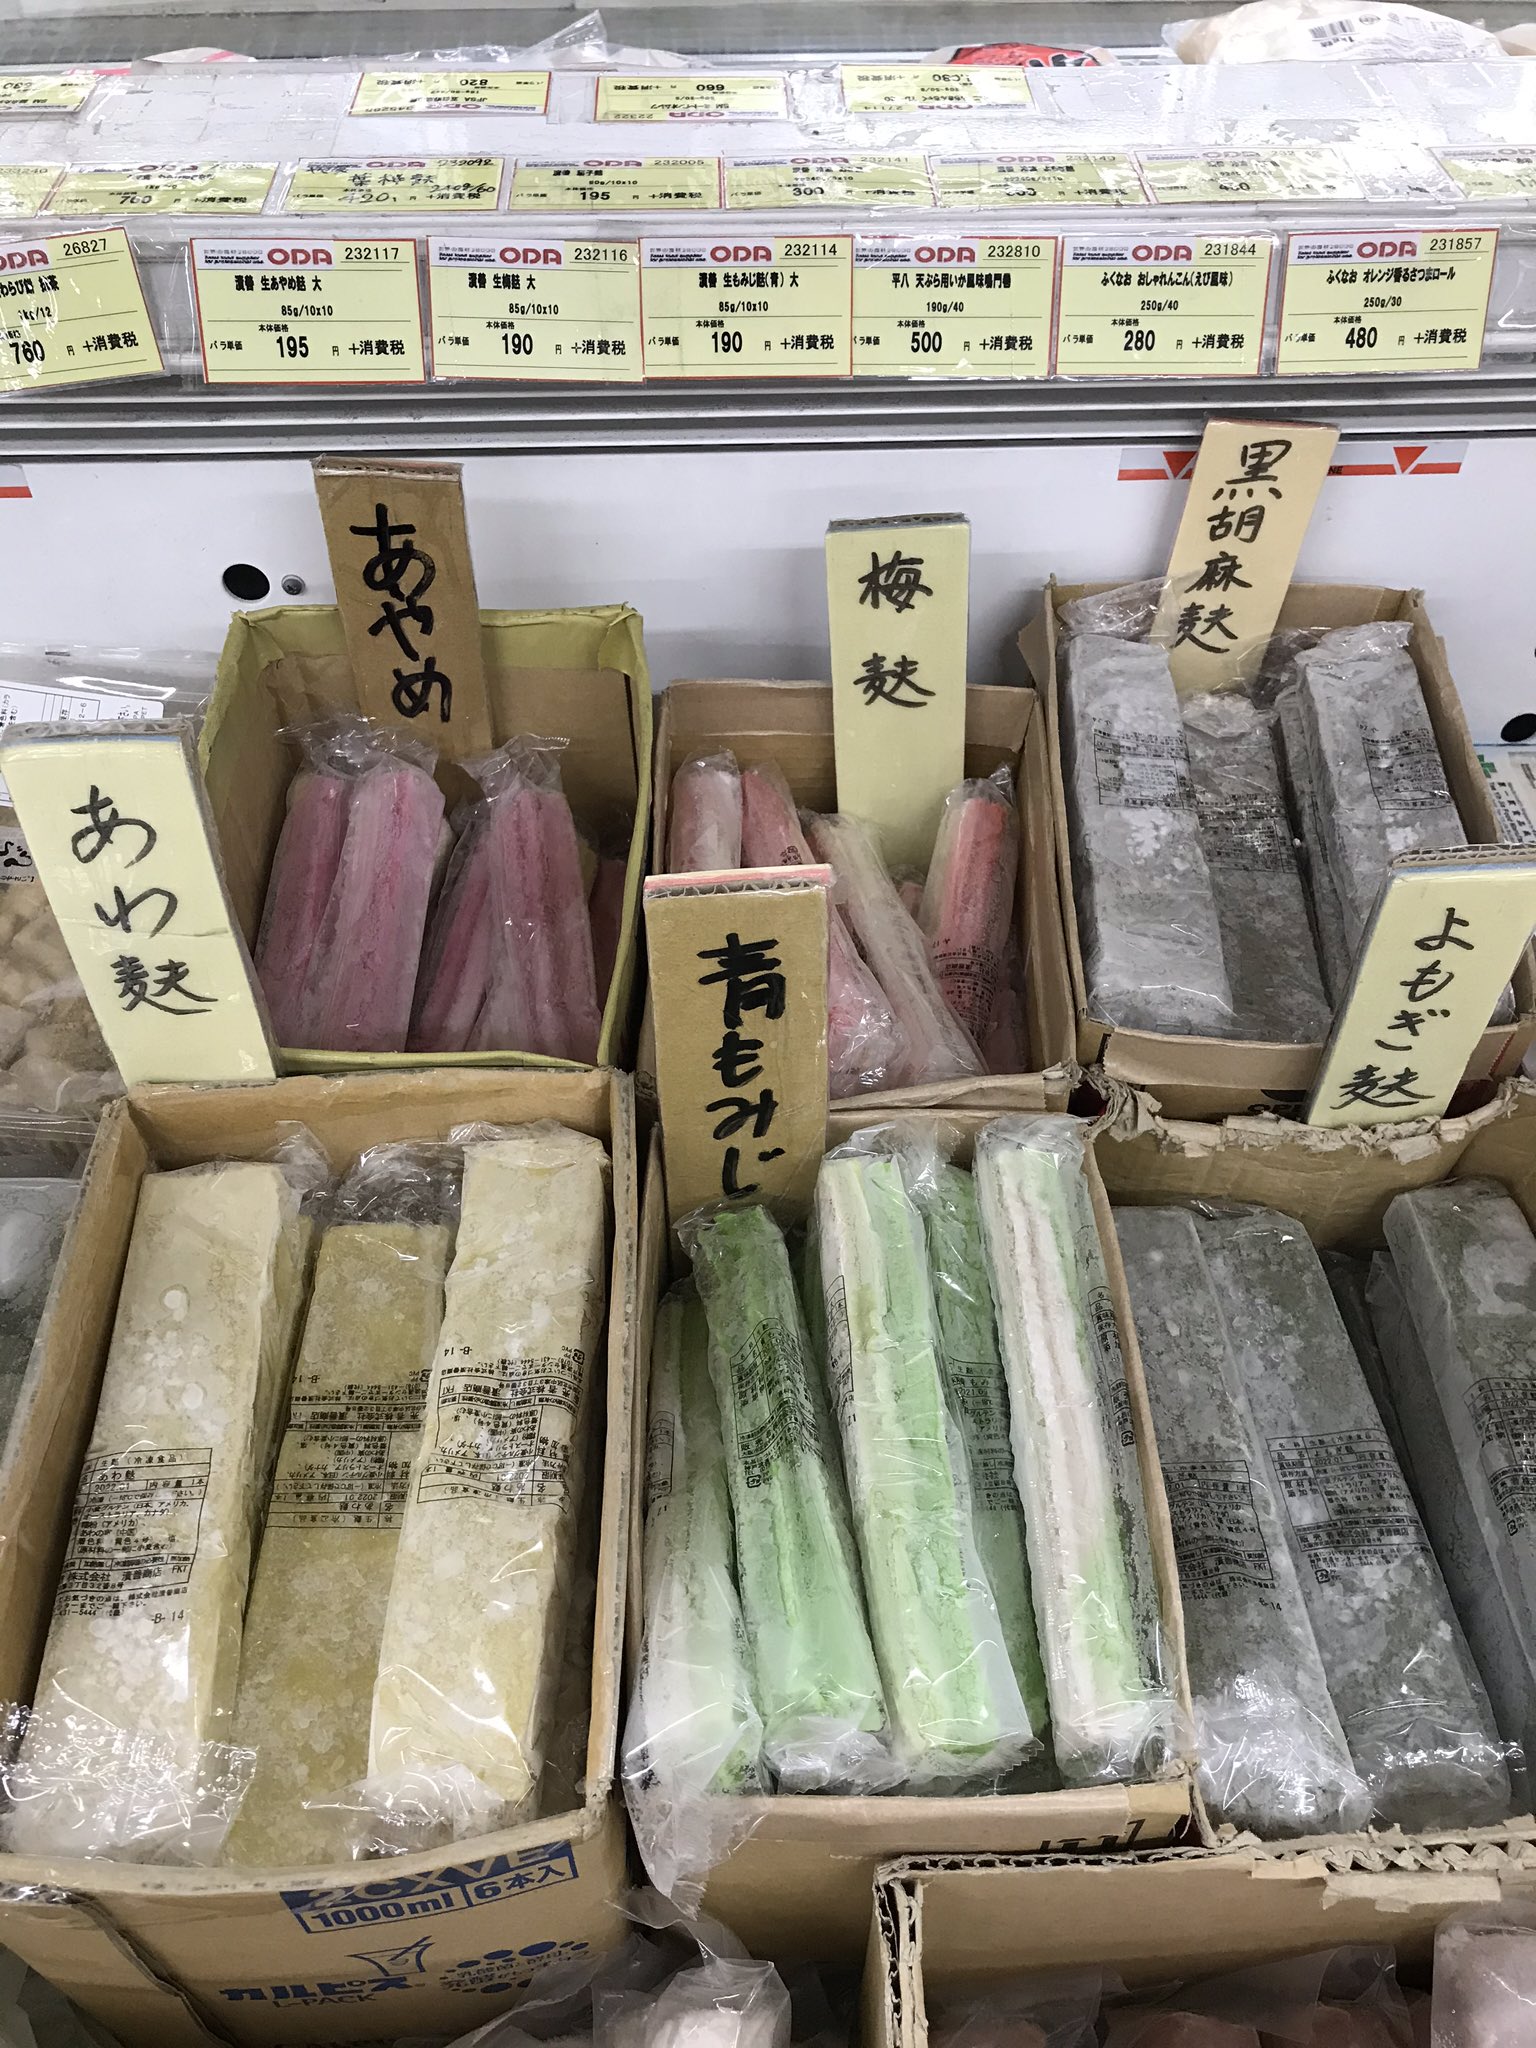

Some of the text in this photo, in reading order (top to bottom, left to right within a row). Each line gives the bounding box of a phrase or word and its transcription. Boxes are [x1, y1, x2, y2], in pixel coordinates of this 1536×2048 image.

[583, 159, 643, 167] ODA
[791, 157, 849, 165] ODA
[996, 155, 1055, 163] ODA
[580, 191, 611, 201] 195
[649, 191, 703, 200] +消費税
[0, 238, 108, 271] DA 26827
[710, 246, 772, 262] ODA
[784, 244, 837, 256] 232114
[914, 246, 976, 263] ODA
[987, 245, 1041, 258] 232810
[1132, 245, 1192, 261] ODA
[1204, 243, 1256, 255] 231844
[1356, 241, 1417, 258] ODA
[1430, 237, 1482, 250] 231857
[267, 248, 333, 265] ODA
[344, 247, 399, 260] 232117
[499, 247, 562, 265] ODA
[574, 248, 628, 261] 232116
[312, 275, 322, 292] 大
[526, 275, 536, 290] 大
[789, 271, 799, 287] 大
[891, 273, 910, 288] 平八
[1101, 271, 1132, 286] ふくなお
[1326, 271, 1358, 284] ふくなお
[509, 303, 559, 315] 85g/10x10
[718, 301, 769, 313] 85g/10x10
[926, 302, 964, 313] 190g/40
[1140, 300, 1179, 311] 250g/40
[1364, 296, 1402, 308] 250g/30
[281, 304, 333, 317] 85g/10x10
[258, 324, 289, 332] 本体価格
[486, 321, 515, 329] 本体価格
[695, 320, 725, 328] 本体価格
[897, 320, 926, 328] 本体価格
[1111, 318, 1139, 326] 本体価格
[1333, 316, 1362, 324] 本体価格
[502, 333, 533, 355] 190
[555, 344, 563, 355] 円
[571, 339, 626, 355] +消費税
[711, 331, 743, 353] 190
[764, 341, 771, 351] 円
[780, 334, 834, 350] +消費税
[911, 331, 942, 353] 500
[964, 341, 970, 351] 円
[979, 336, 1033, 351] +消費税
[1124, 330, 1155, 351] 280
[1176, 340, 1182, 350] 円
[1192, 334, 1244, 349] +消費税
[1345, 327, 1377, 348] 480
[1398, 336, 1405, 345] 円
[1414, 328, 1467, 344] +消費税
[9, 331, 139, 365] 760 円 +消費税
[276, 336, 309, 358] 195
[332, 345, 340, 356] 円
[348, 340, 405, 355] +消費税
[1169, 439, 1293, 654] 黒胡麻麩
[349, 502, 453, 723] あやめ
[853, 550, 936, 708] 梅麩
[70, 784, 219, 1016] あわ麩
[1330, 907, 1475, 1110] よもぎ麩
[696, 932, 787, 1201] 青もみじ
[171, 1564, 189, 1574] FKT
[311, 1864, 566, 1928] 1000ml 6本入
